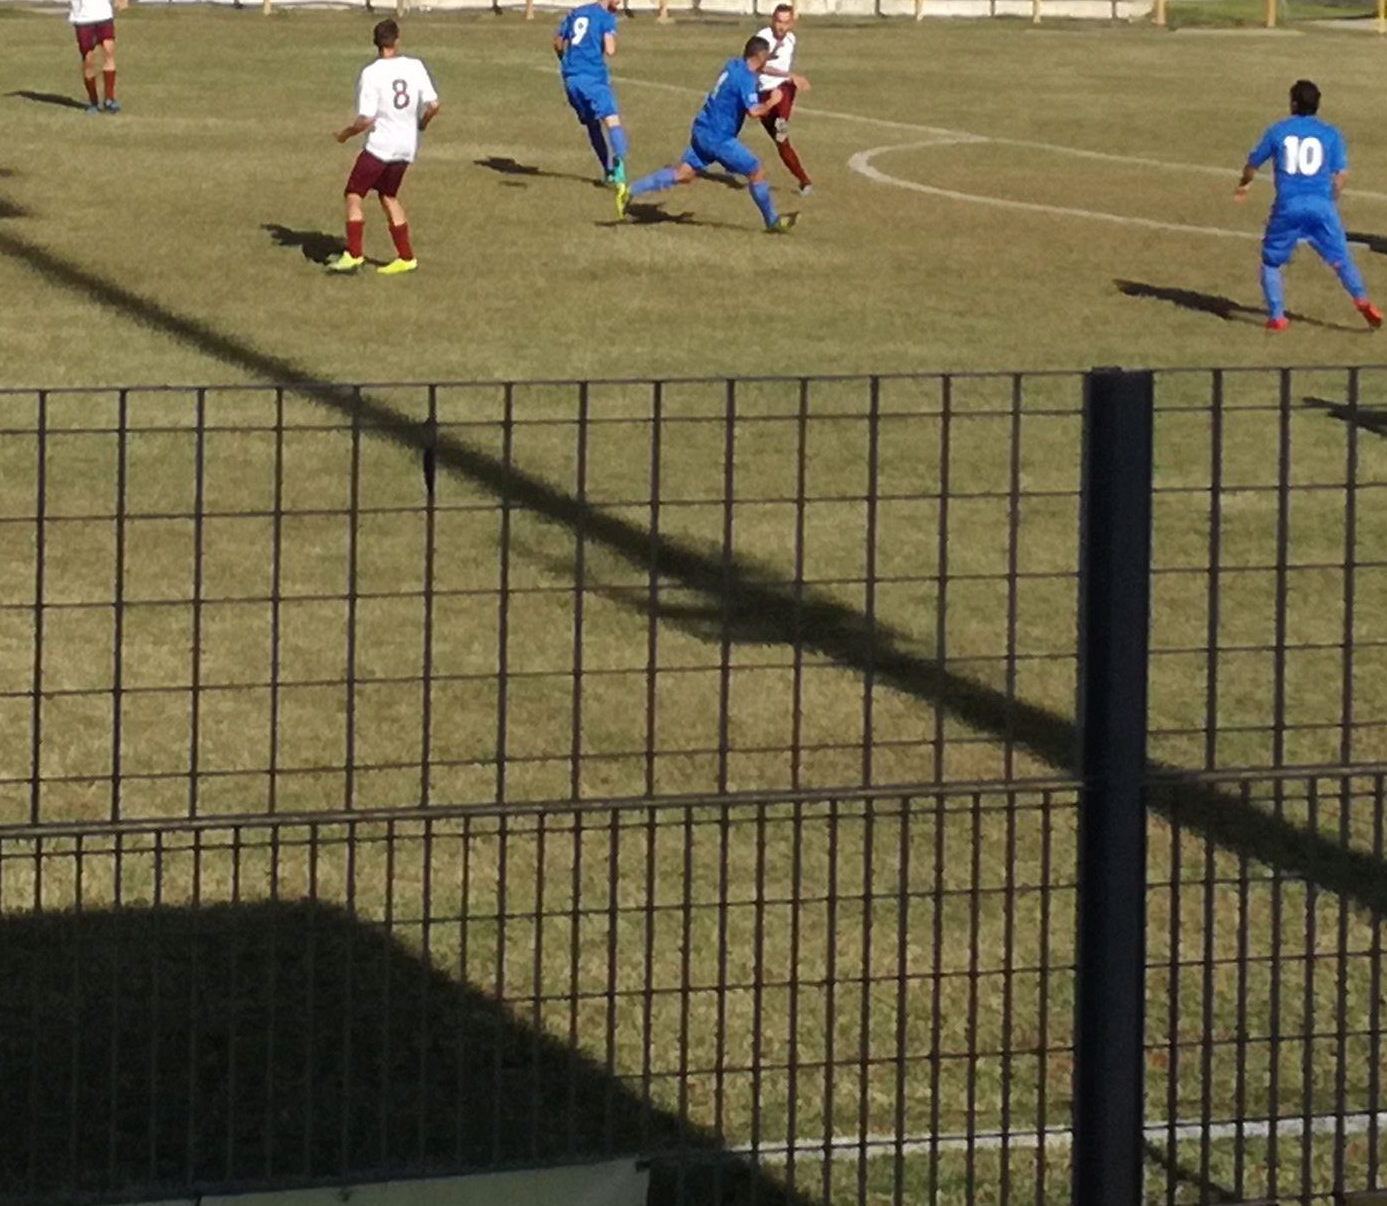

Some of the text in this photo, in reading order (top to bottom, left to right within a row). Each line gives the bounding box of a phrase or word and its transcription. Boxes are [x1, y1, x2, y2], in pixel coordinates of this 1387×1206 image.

[571, 16, 590, 46] 9
[393, 78, 410, 110] 8
[1283, 135, 1323, 176] 10
